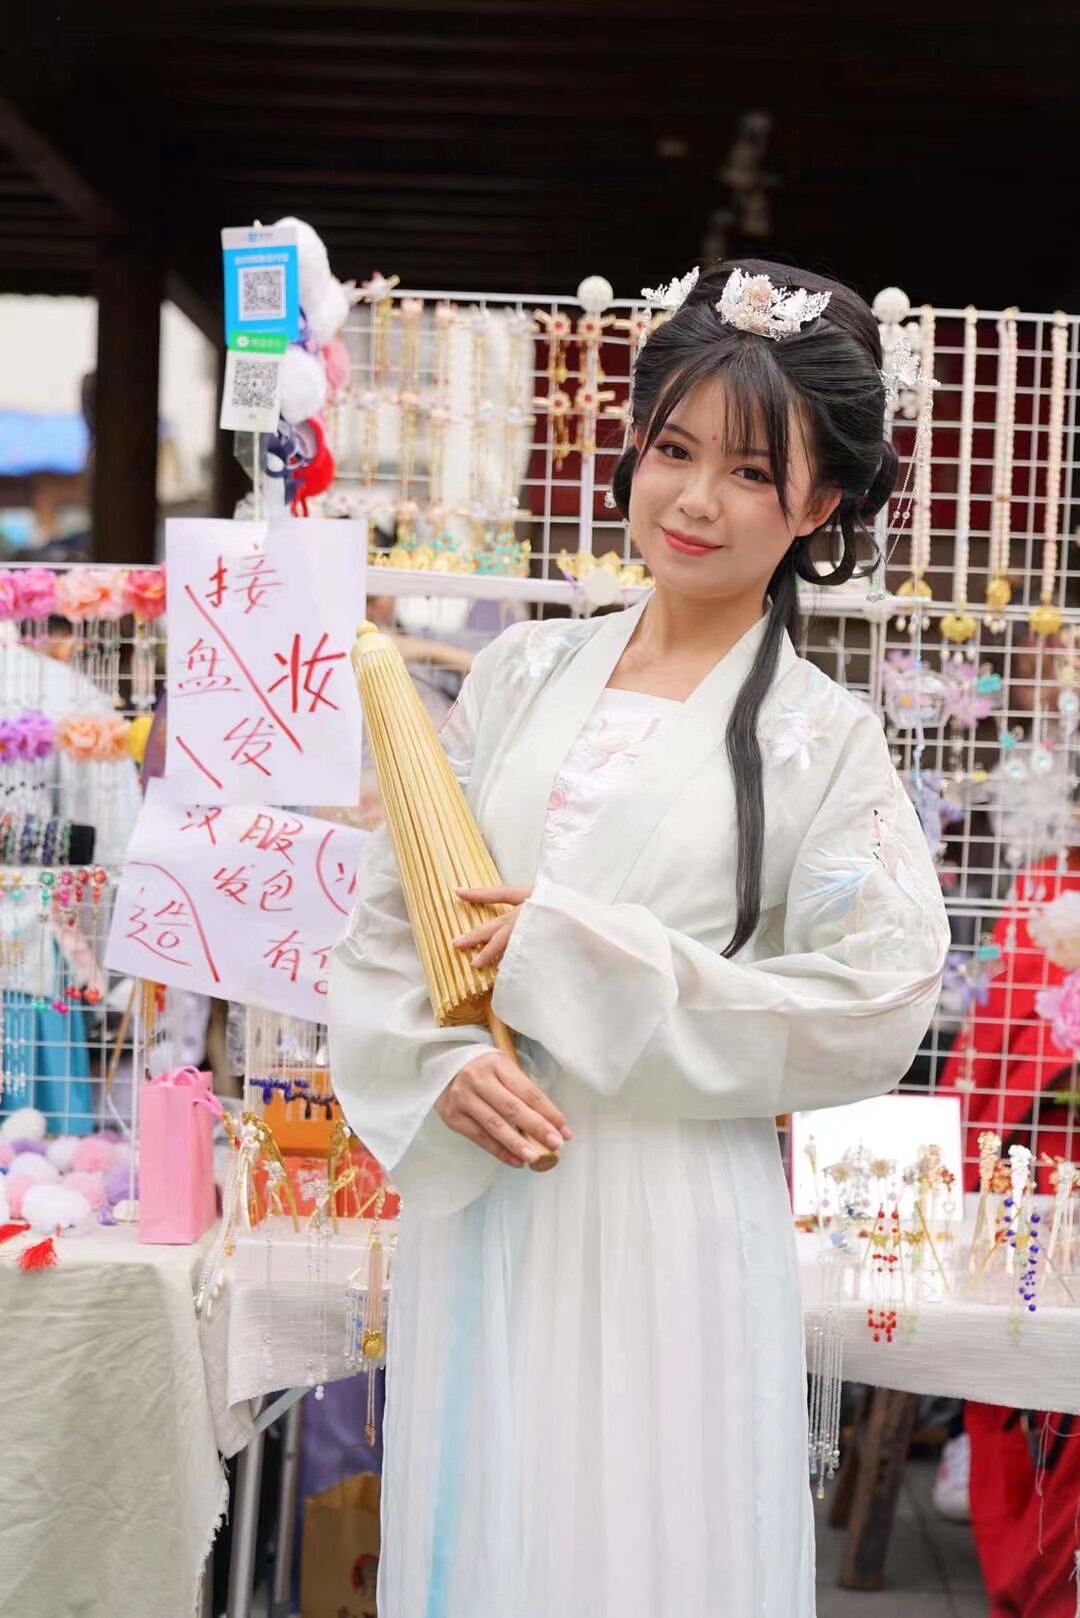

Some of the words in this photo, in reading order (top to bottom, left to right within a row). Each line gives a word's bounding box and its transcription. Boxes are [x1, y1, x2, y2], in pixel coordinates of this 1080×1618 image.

[206, 544, 284, 614] 接
[173, 639, 240, 698] 盘
[268, 633, 346, 713] 妆
[223, 717, 277, 776] 发
[126, 888, 192, 967] 造
